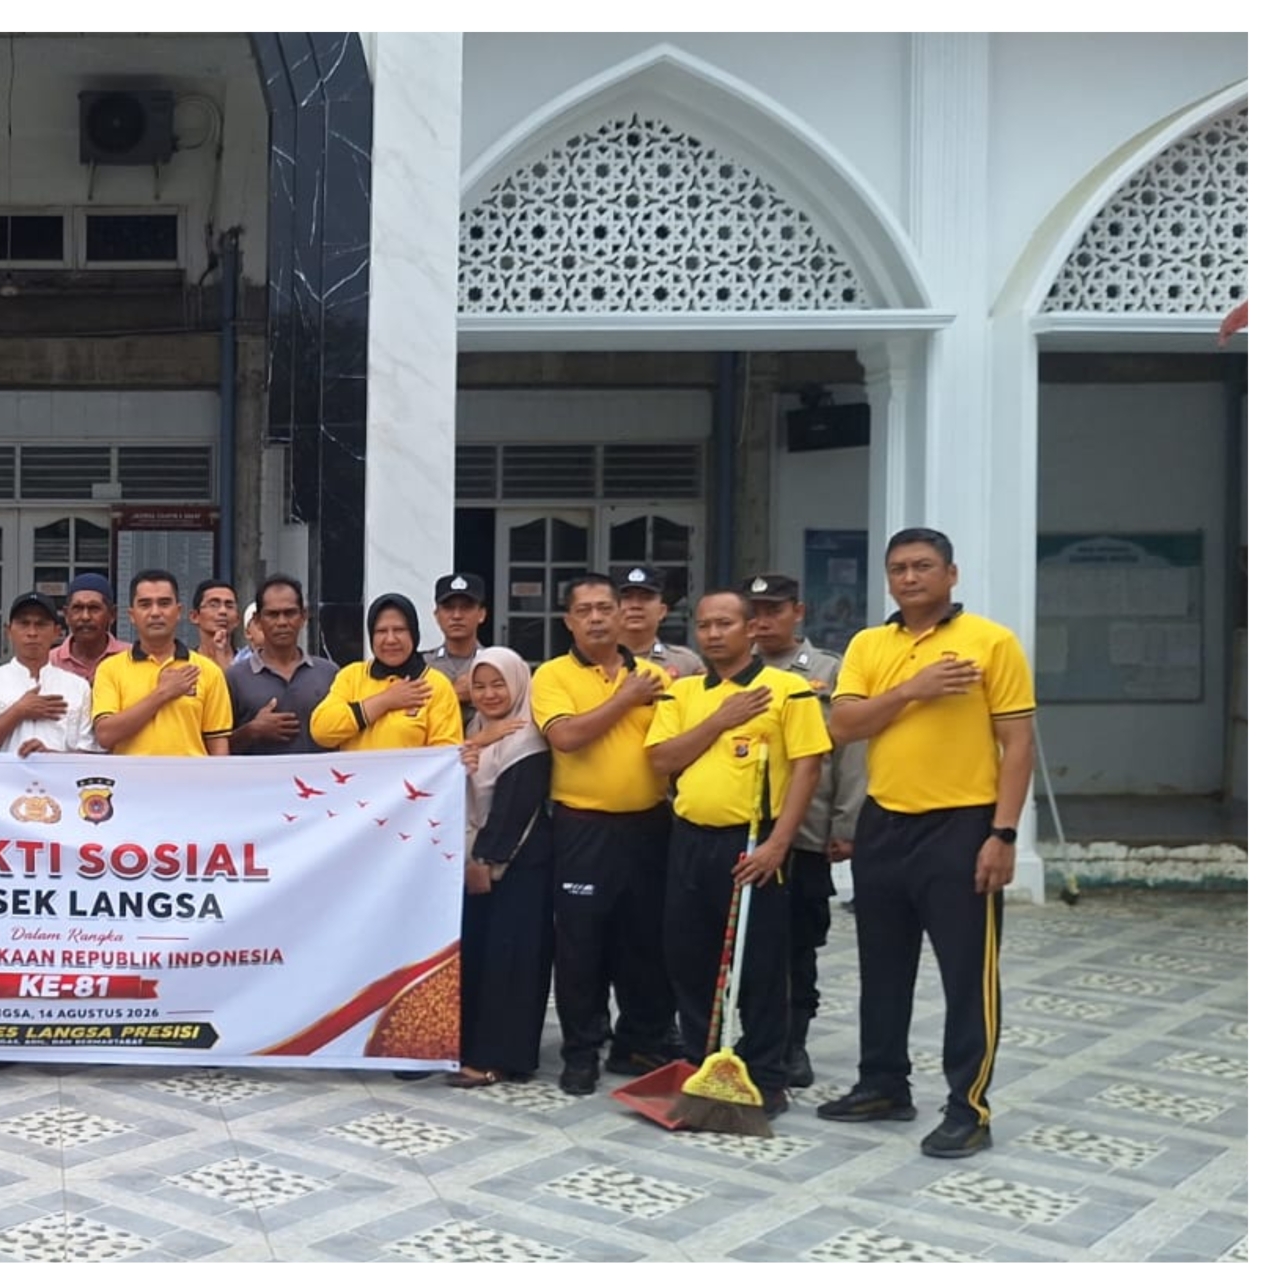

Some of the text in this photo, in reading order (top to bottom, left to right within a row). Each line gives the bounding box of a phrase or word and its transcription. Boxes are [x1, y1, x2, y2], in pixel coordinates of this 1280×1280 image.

[77, 842, 270, 882] SOSIAL
[69, 890, 223, 919] LANGSA
[11, 927, 124, 946] Dalam Rangka
[62, 950, 162, 969] REPUBLIK
[168, 948, 284, 969] INDONESIA
[19, 975, 110, 998] KE-81
[40, 1009, 53, 1018] 14
[57, 1009, 123, 1018] AGUSTUS
[127, 1009, 159, 1018] 2026
[26, 1026, 112, 1039] LANGSA
[121, 1025, 200, 1040] PRESISI
